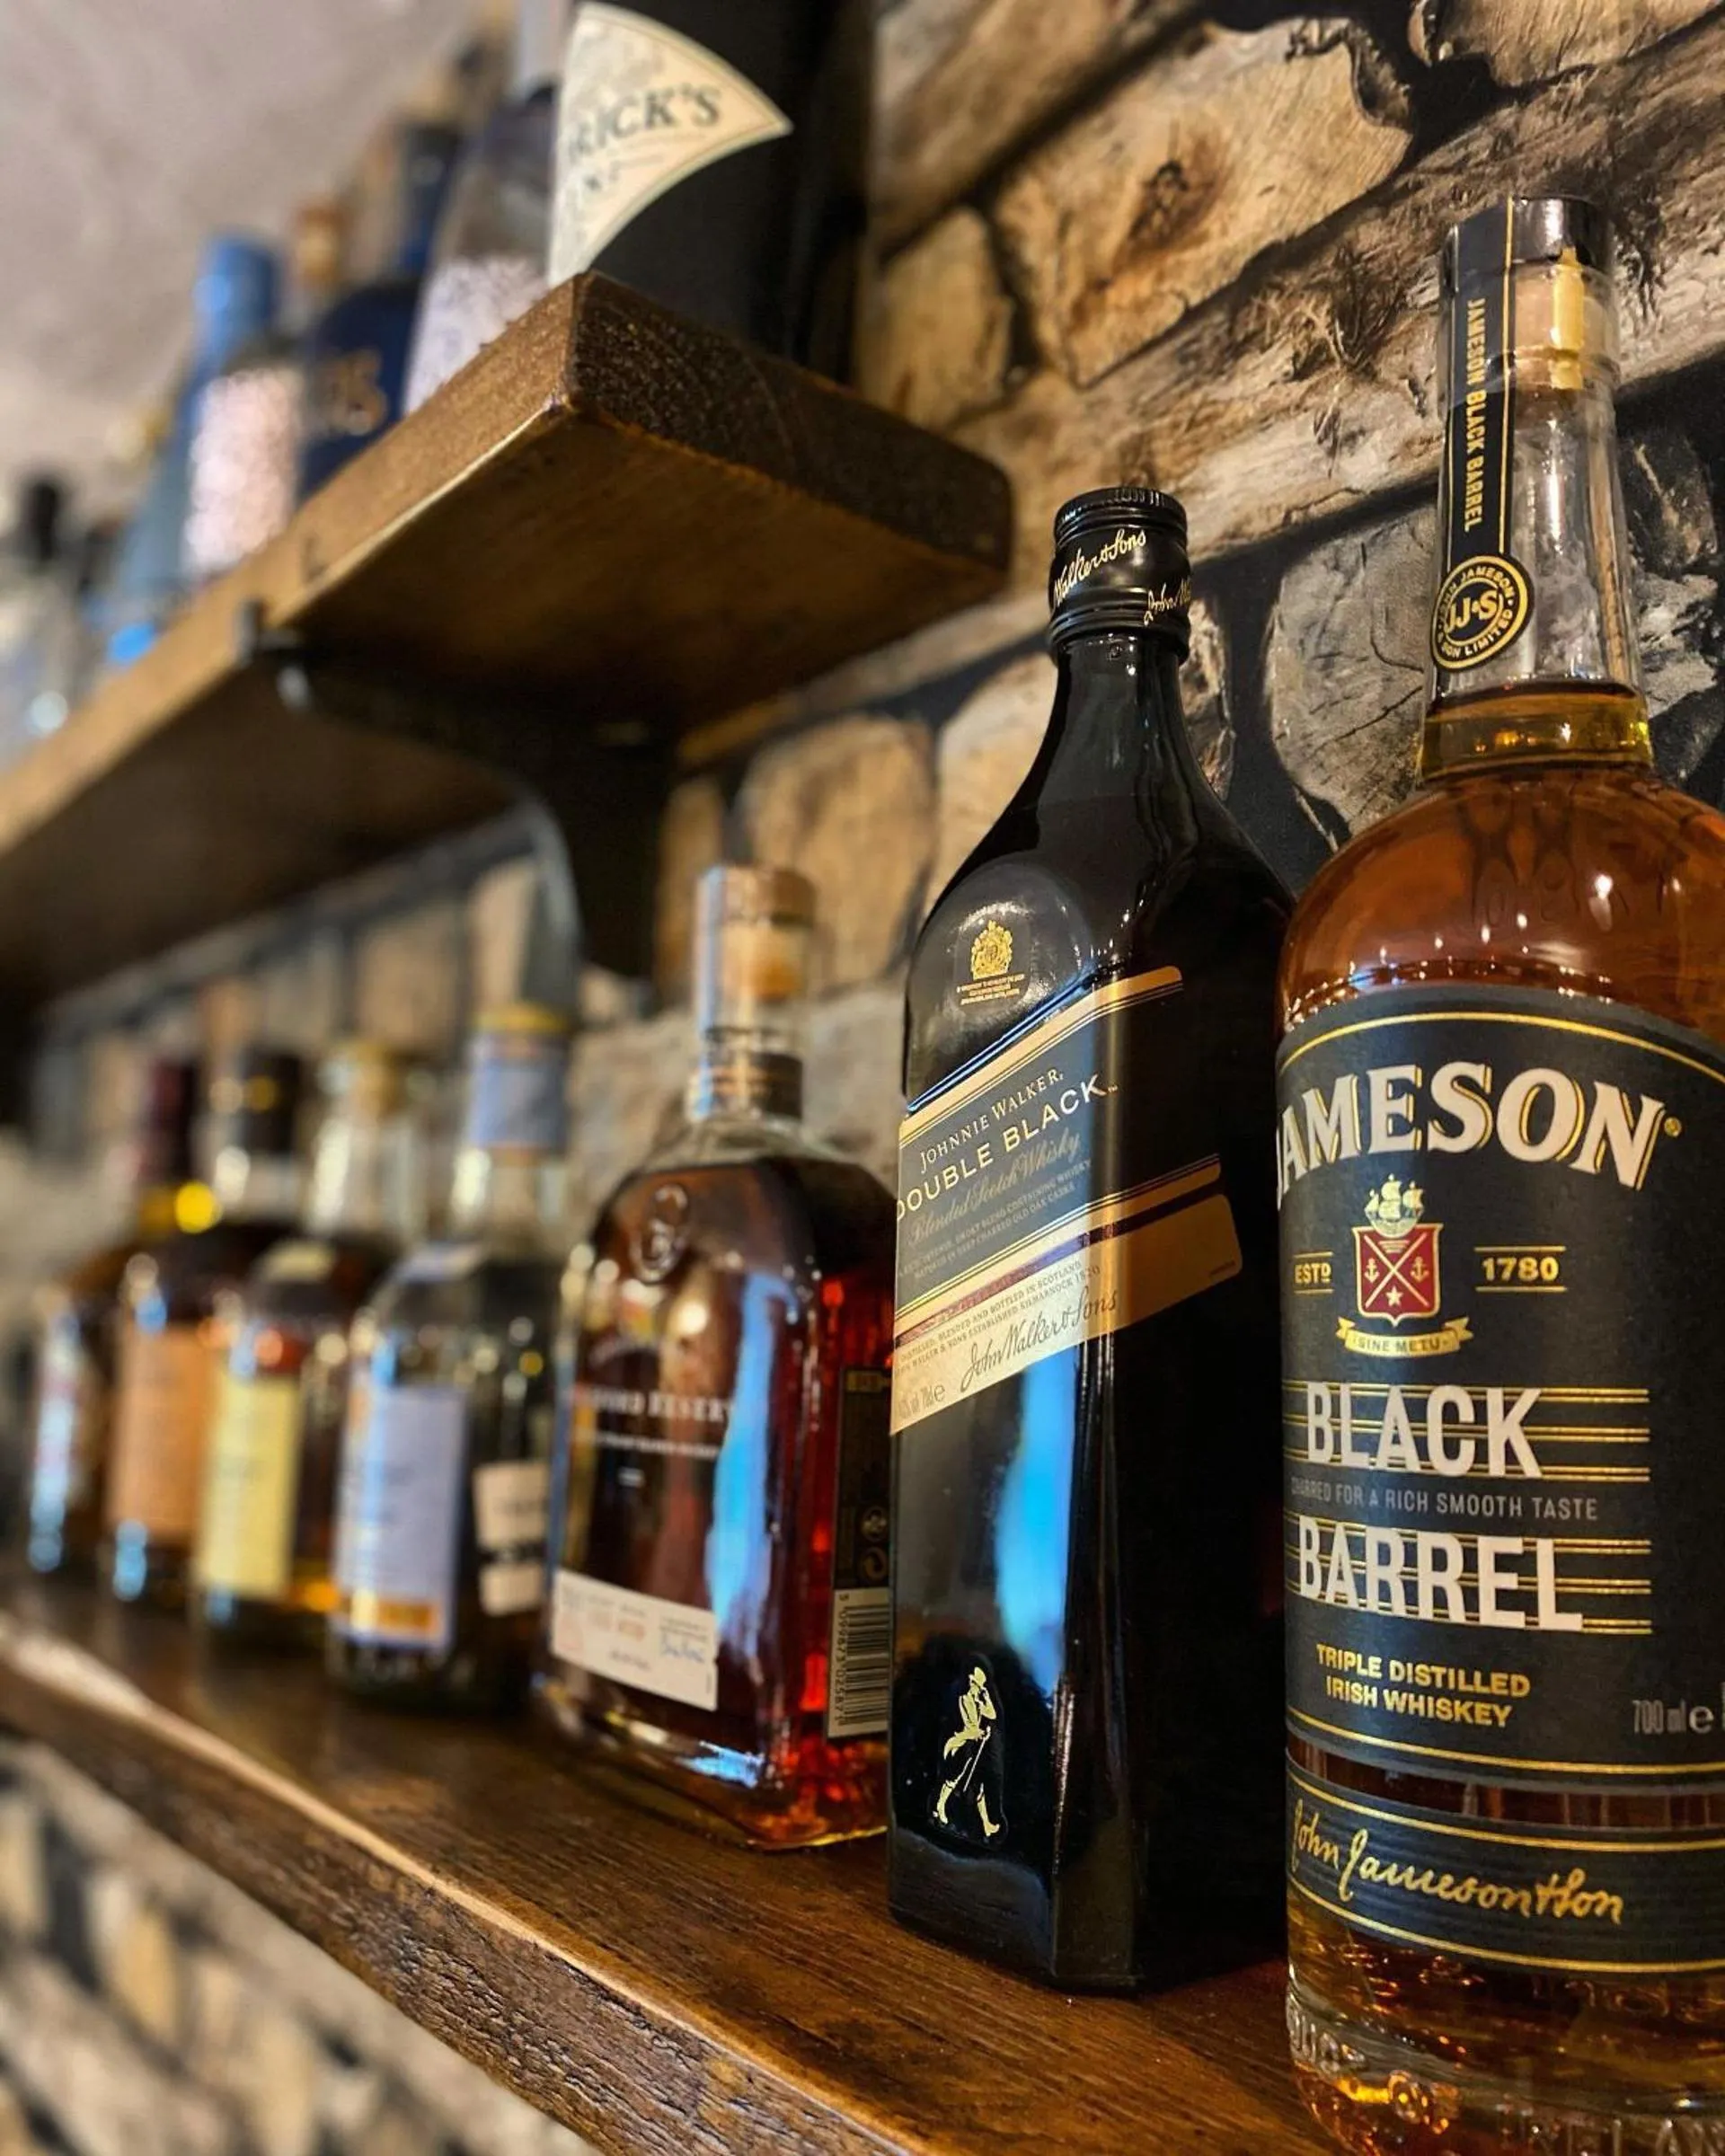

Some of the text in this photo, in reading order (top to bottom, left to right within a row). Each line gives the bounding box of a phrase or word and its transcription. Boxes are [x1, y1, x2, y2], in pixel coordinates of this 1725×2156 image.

[1464, 298, 1487, 533] JAMESON BLACK BARREL
[1461, 566, 1516, 597] JAMESON
[1464, 609, 1513, 655] LIMITED
[896, 1074, 1108, 1222] DOUBLE BLACK
[920, 1115, 989, 1174] JOHNNIE
[1482, 1257, 1560, 1282] 1780
[1307, 1380, 1543, 1479] BLACK
[1335, 1482, 1365, 1507] FOR
[1367, 1491, 1380, 1509] A
[1384, 1489, 1429, 1514] RICH
[1436, 1492, 1523, 1518] SMOOTH
[1531, 1498, 1598, 1521] TASTE
[1298, 1515, 1584, 1631] BARREL
[1316, 1643, 1531, 1698] TRIPLE DISTILLED
[1325, 1674, 1513, 1728] IRISH WHISKEY
[1338, 1828, 1531, 1902] Jameson
